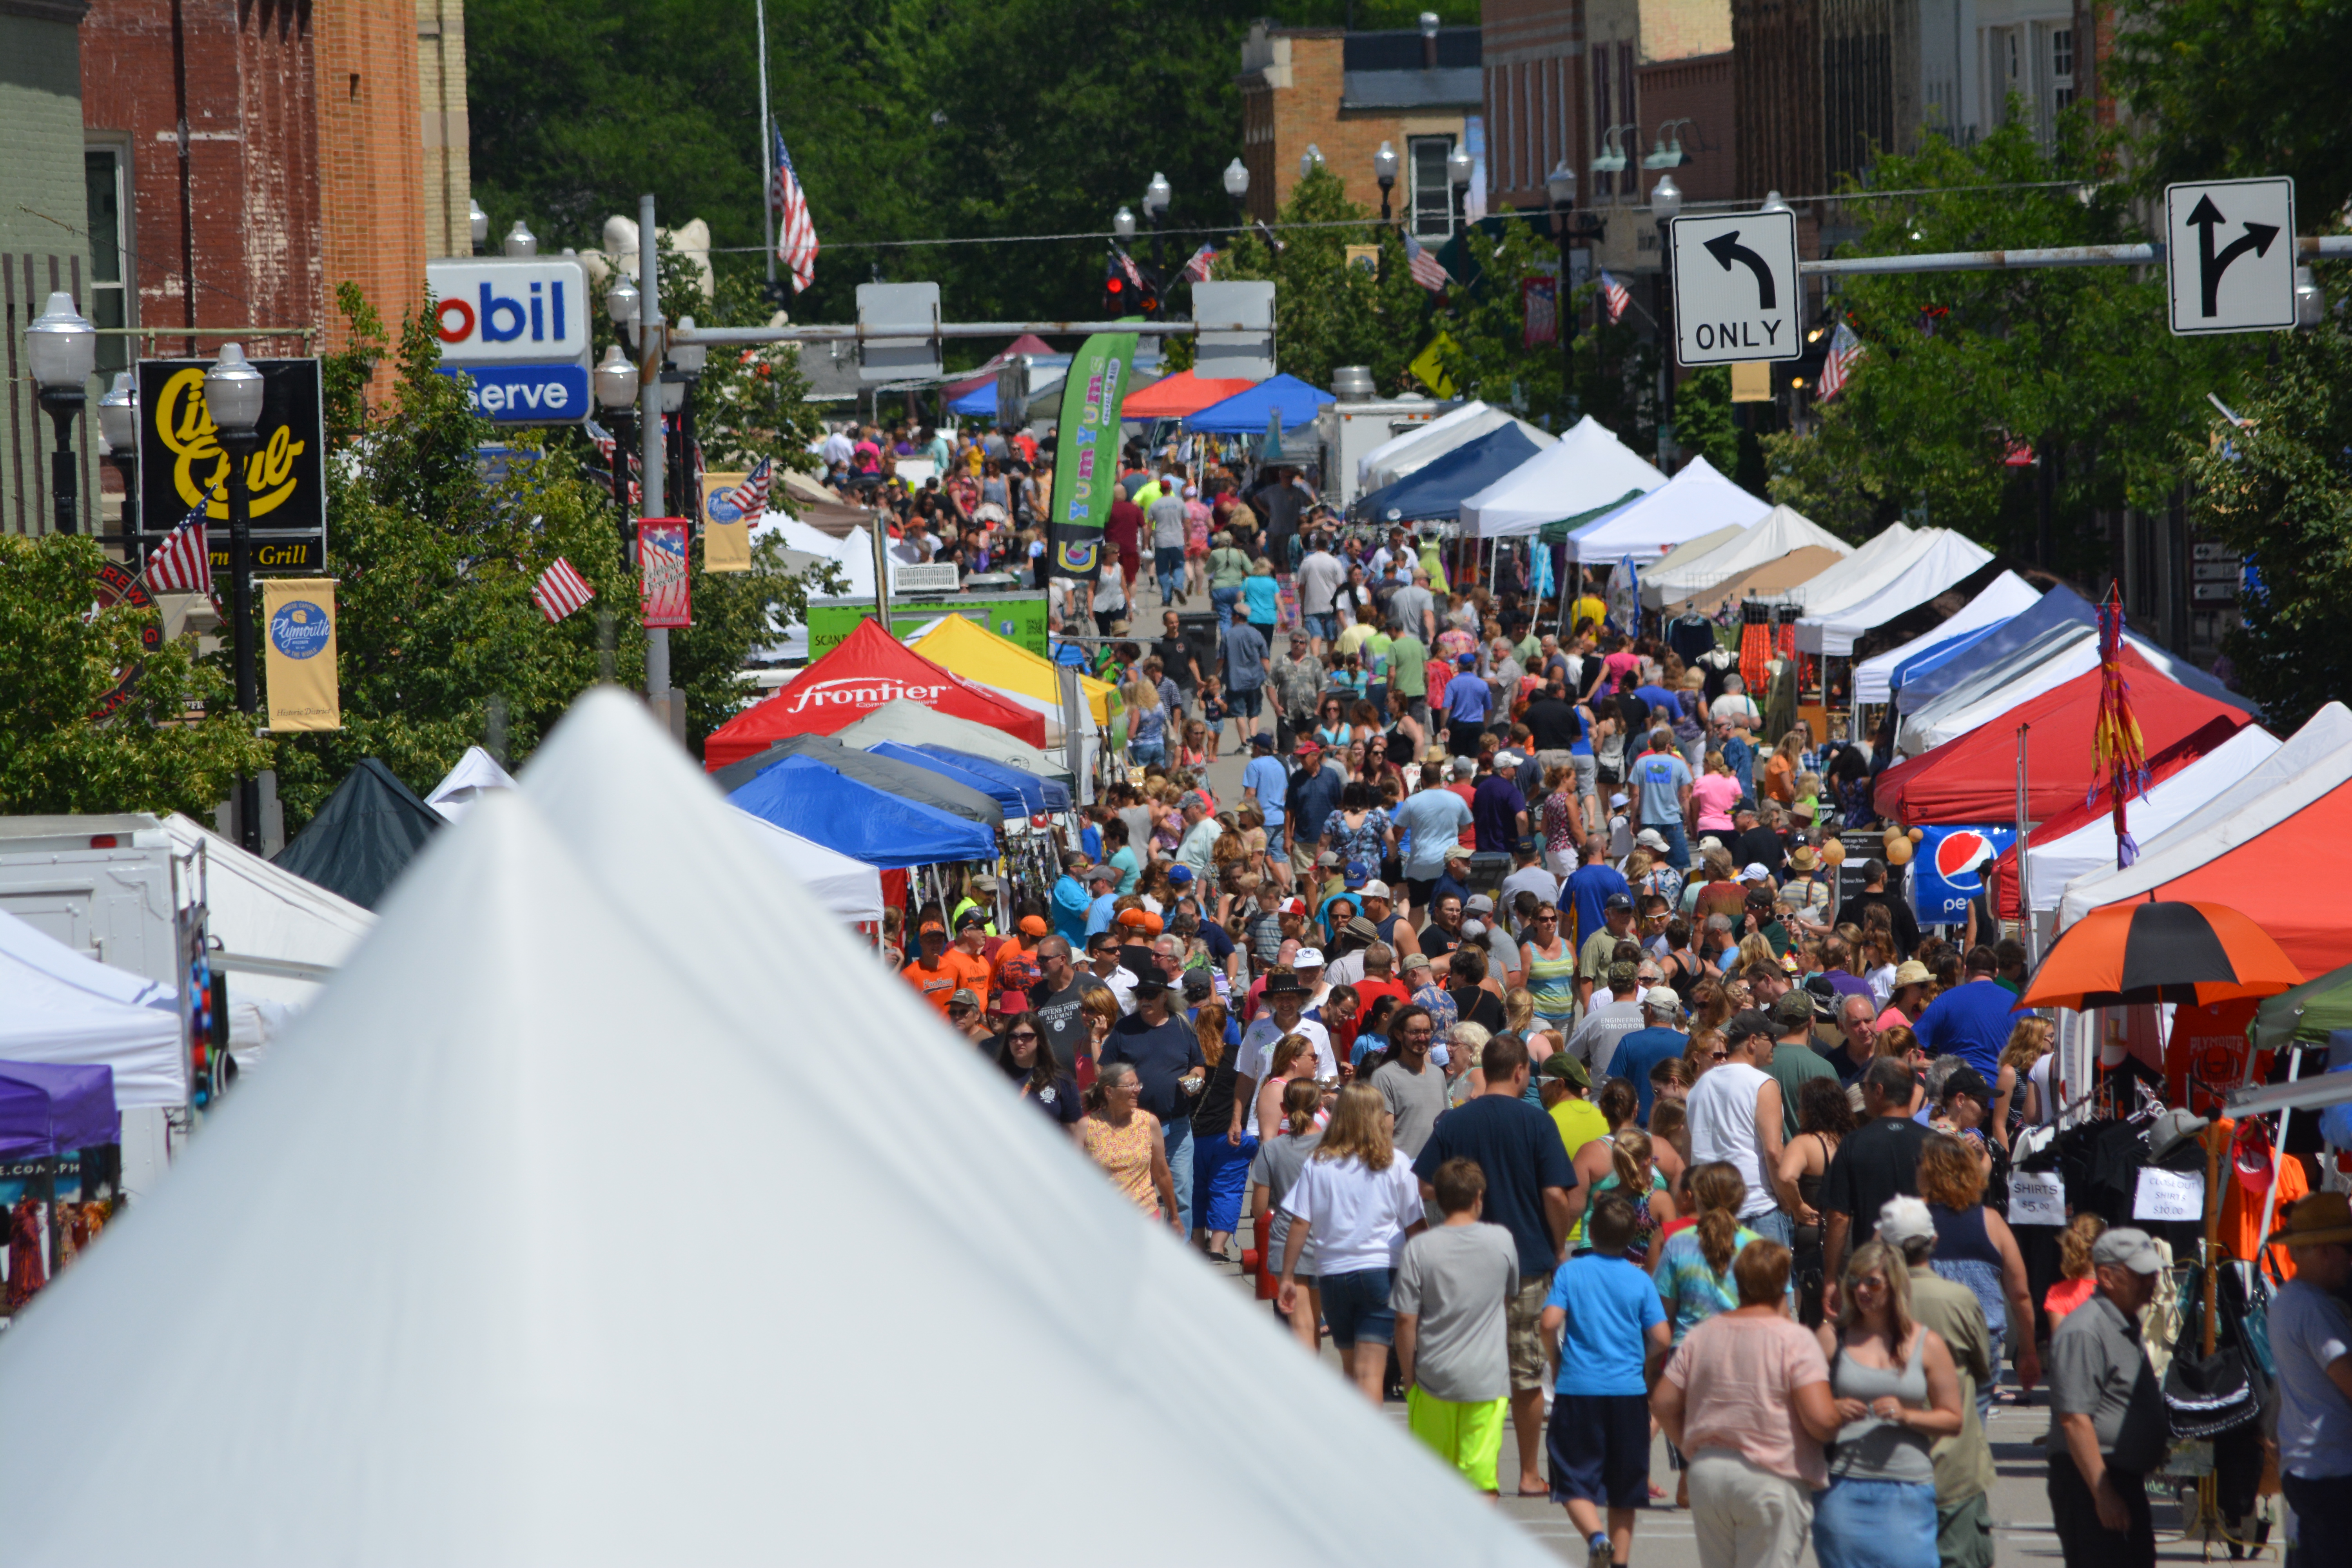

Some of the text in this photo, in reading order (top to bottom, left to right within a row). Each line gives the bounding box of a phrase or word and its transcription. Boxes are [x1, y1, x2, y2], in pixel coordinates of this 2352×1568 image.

[434, 281, 564, 343] obil
[1696, 319, 1782, 350] ONLY
[258, 545, 307, 564] Grill
[648, 571, 687, 591] Freedom
[271, 617, 330, 648] Plymouth
[815, 634, 840, 646] SCAN
[787, 677, 946, 713] frontier
[1038, 1003, 1081, 1017] STEVENS POINT
[1046, 1011, 1073, 1021] ALUMNI
[2189, 1036, 2244, 1056] PLYMOUTH
[2014, 1183, 2058, 1195] SHIRTS
[2149, 1177, 2196, 1190] CLOSEOUT
[2155, 1191, 2186, 1201] SHIRTS
[2022, 1200, 2049, 1212] $5.00
